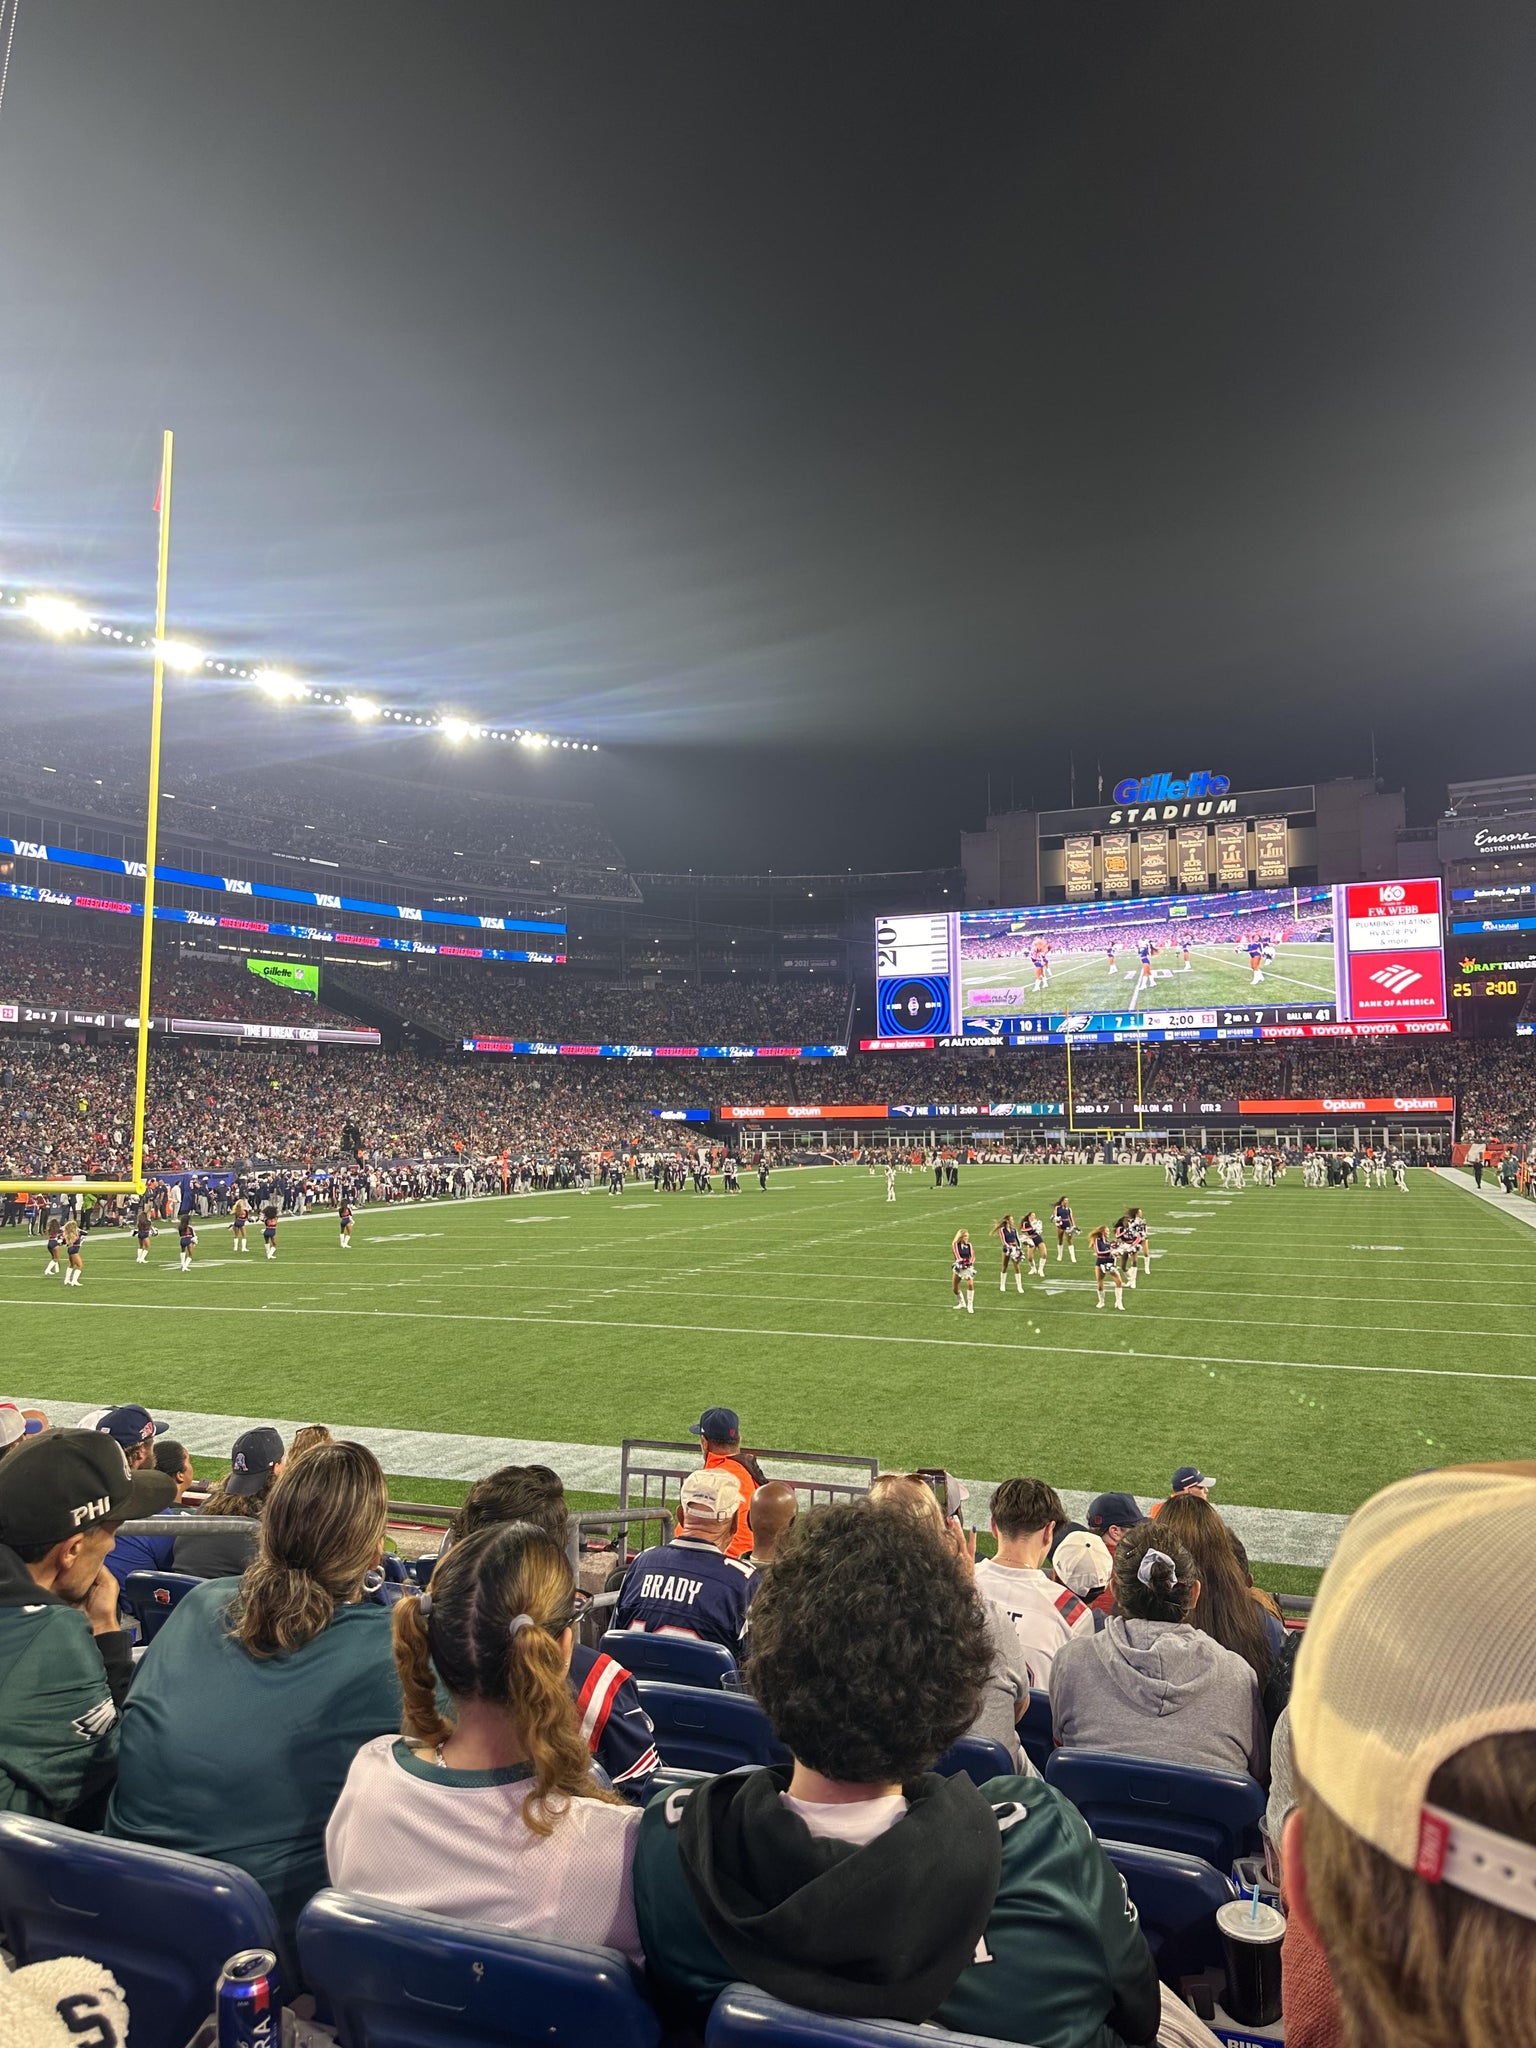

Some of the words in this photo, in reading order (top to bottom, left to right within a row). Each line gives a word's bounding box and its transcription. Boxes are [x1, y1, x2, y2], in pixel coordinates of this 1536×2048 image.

[1113, 770, 1230, 805] Gillette
[1109, 799, 1237, 825] STADIUM
[1474, 829, 1536, 846] Encore
[10, 839, 48, 860] VISA
[1480, 845, 1509, 853] BOSTON
[1510, 843, 1536, 851] HARBO
[122, 860, 155, 878] VIS
[1220, 871, 1244, 880] 2016
[1260, 868, 1284, 877] 2018
[1105, 881, 1128, 889] 2003
[1142, 878, 1166, 886] 2004
[1181, 874, 1204, 883] 2014
[222, 878, 252, 895] VISA
[1379, 885, 1406, 903] 160
[75, 896, 132, 914] CHEERLEADERS
[314, 893, 342, 909] VISA
[397, 906, 422, 920] VISA
[1388, 904, 1419, 915] WEBB
[478, 917, 505, 929] VISA
[1355, 920, 1395, 928] PLUMBING
[263, 966, 293, 978] Gillette
[1462, 960, 1536, 974] DRAFTKINGS
[1453, 983, 1472, 997] 25
[1485, 980, 1517, 996] 2:00
[1358, 1000, 1382, 1008] BANK
[1396, 998, 1435, 1006] AMERICA
[50, 1012, 57, 1023] 7
[94, 1015, 105, 1026] 41
[1115, 1017, 1122, 1027] 7
[1255, 1012, 1263, 1023] 7
[1315, 1009, 1330, 1021] 41
[1019, 1020, 1033, 1032] 10
[1263, 1027, 1304, 1037] TOYOTA
[1310, 1025, 1354, 1035] TOYOTA
[1355, 1023, 1399, 1034] TOYOTA
[1405, 1021, 1449, 1033] TOYOTA
[896, 1040, 926, 1048] balance
[951, 1036, 1004, 1047] AUTODESK
[732, 1107, 765, 1117] Optum
[787, 1106, 822, 1117] Optum
[916, 1106, 929, 1115] NE
[939, 1105, 949, 1114] 10
[959, 1106, 978, 1115] 2:00
[1016, 1106, 1032, 1114] PHI
[1047, 1105, 1054, 1114] 7
[1075, 1105, 1095, 1113] 2ND
[1103, 1104, 1110, 1113] 7
[1149, 1104, 1159, 1112] ON
[1161, 1104, 1173, 1112] 41
[1200, 1103, 1214, 1113] QTR
[1214, 1104, 1222, 1112] 2
[1323, 1100, 1366, 1113] Optum
[1394, 1098, 1438, 1111] Optum
[70, 1496, 111, 1527] PHI
[640, 1574, 703, 1605] BRADY
